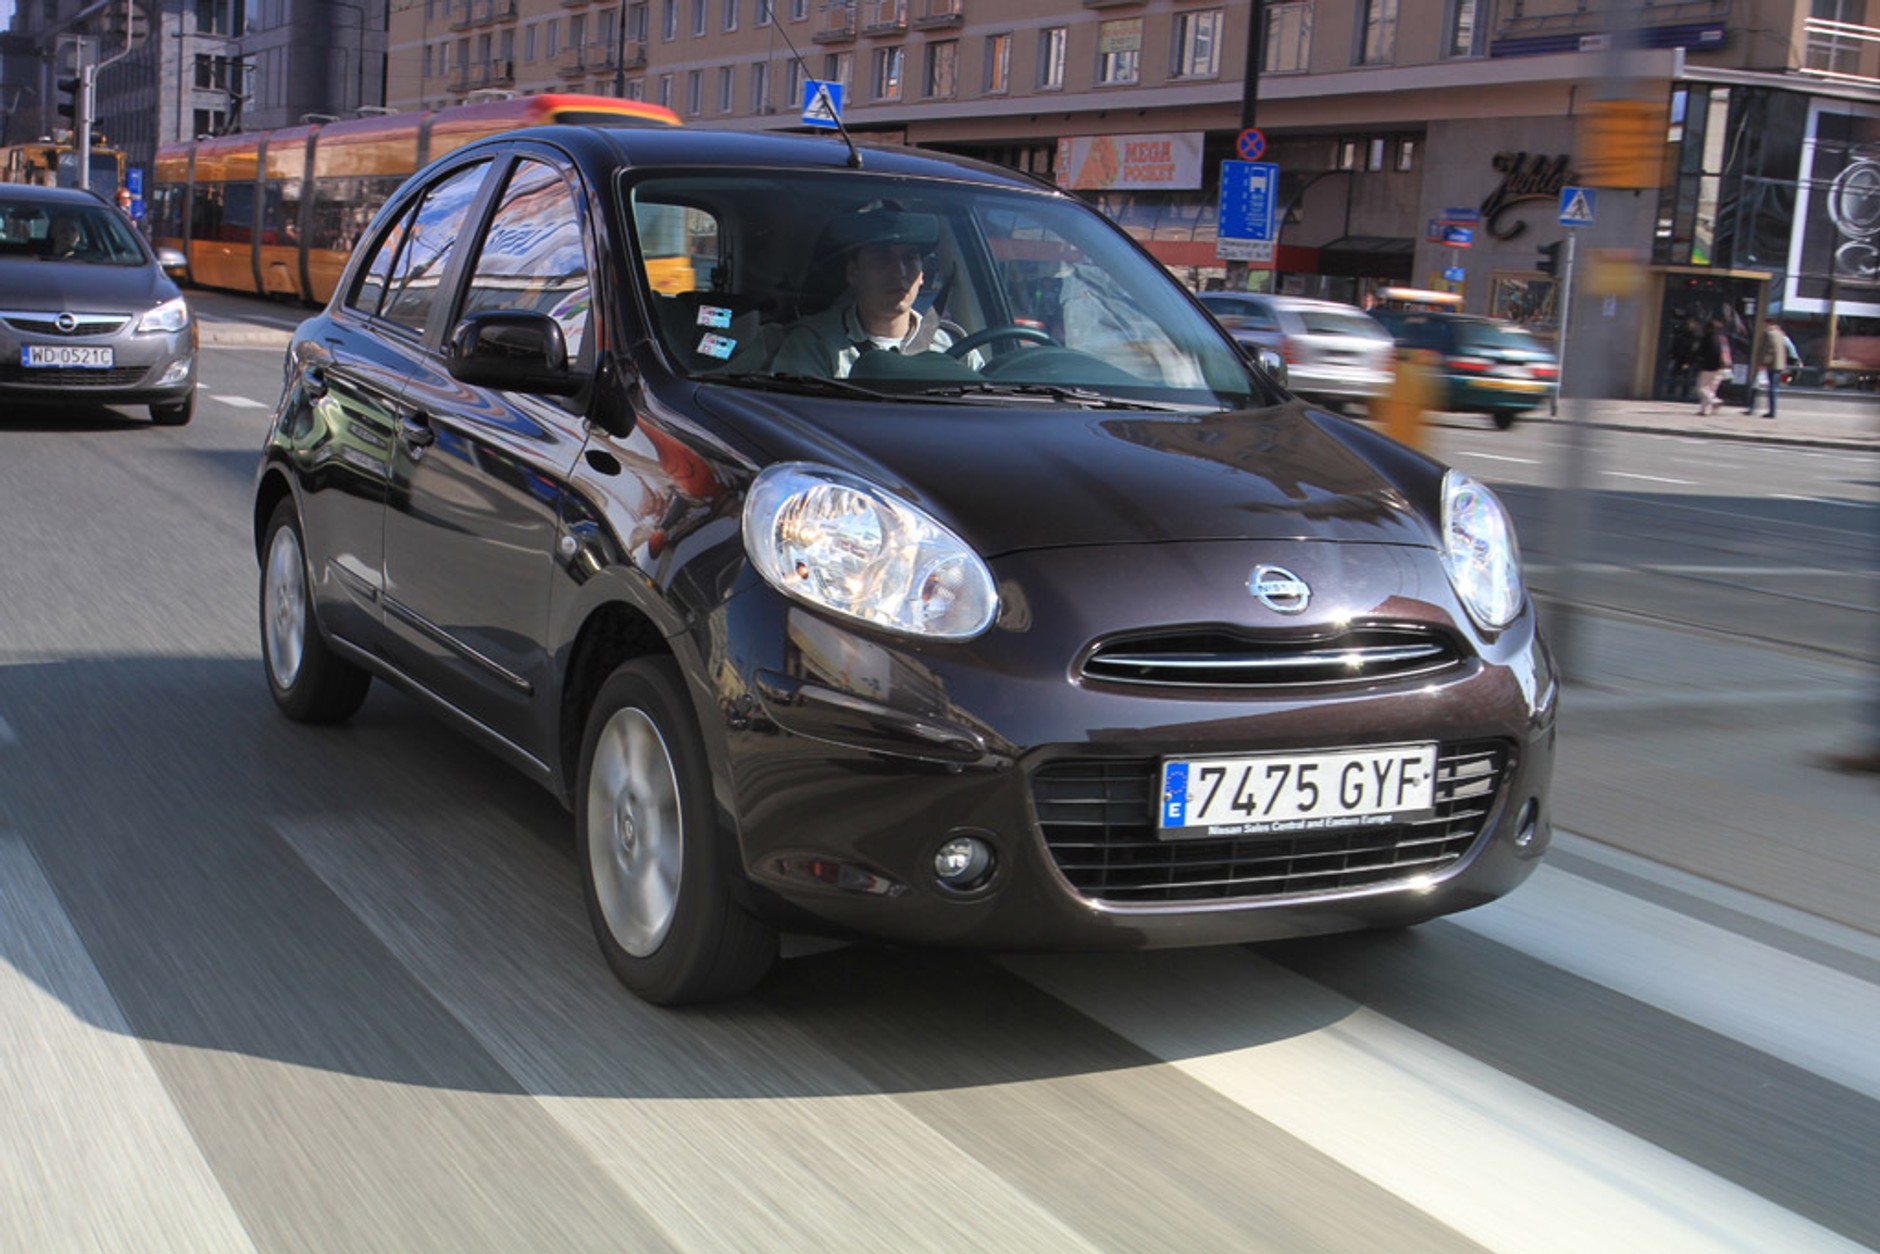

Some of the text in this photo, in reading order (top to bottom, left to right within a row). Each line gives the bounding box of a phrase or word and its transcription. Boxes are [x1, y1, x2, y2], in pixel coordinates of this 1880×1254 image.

[1125, 141, 1171, 162] MEGA
[1122, 163, 1175, 182] POCKET
[31, 348, 54, 363] WD
[61, 348, 111, 365] 0521C
[1197, 758, 1422, 818] 7475 GYF
[1168, 802, 1181, 817] E
[1208, 814, 1393, 836] Nissan Sales Central and Eastern Europe
